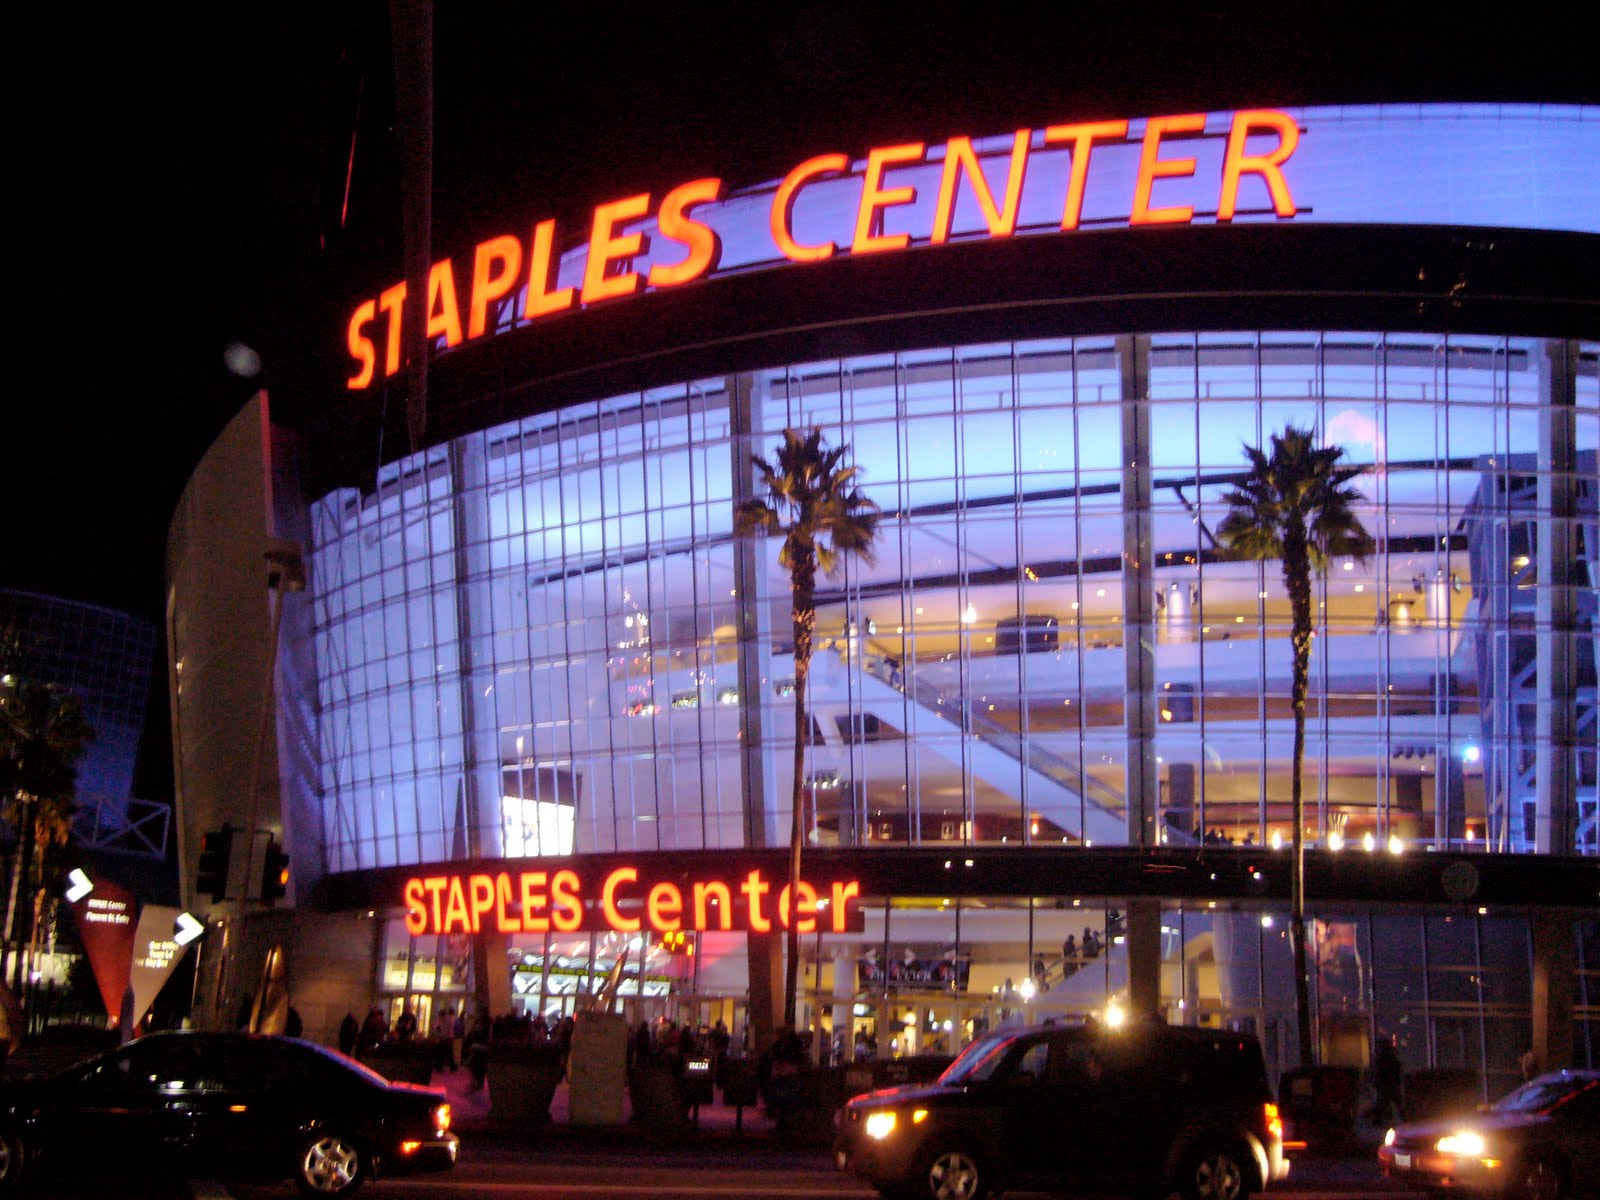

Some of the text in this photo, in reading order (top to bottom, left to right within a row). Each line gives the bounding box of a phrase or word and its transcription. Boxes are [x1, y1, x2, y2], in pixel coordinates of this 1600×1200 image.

[347, 107, 1300, 389] STAPLES CENTER
[404, 867, 859, 936] STAPLES Center
